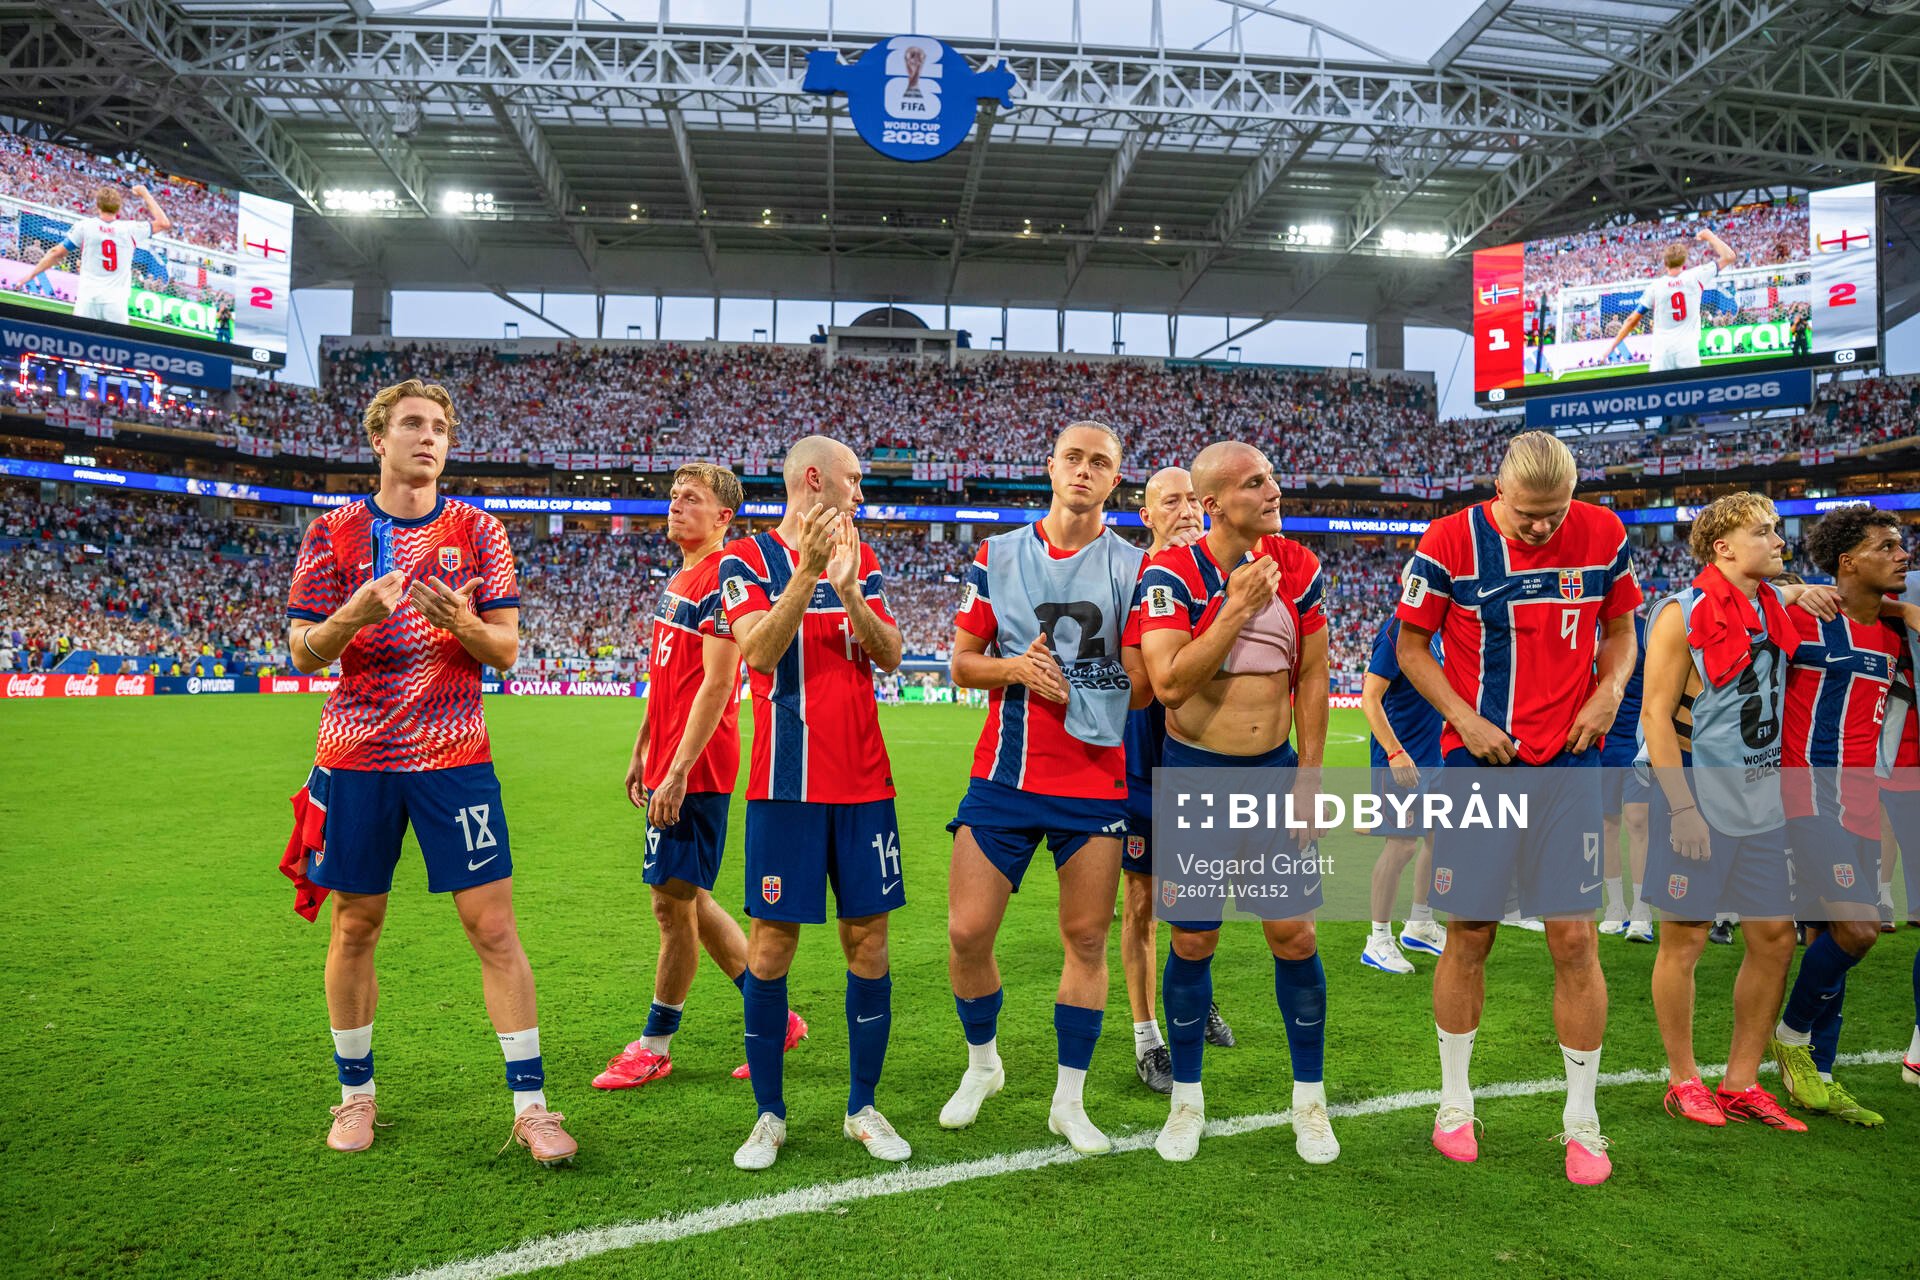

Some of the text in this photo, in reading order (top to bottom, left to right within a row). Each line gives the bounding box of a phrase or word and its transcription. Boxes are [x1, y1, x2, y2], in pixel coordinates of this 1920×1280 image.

[901, 101, 926, 112] FIFA
[883, 121, 941, 132] WORLD CUP
[882, 131, 941, 145] 2026
[101, 239, 118, 272] 9
[250, 286, 273, 310] 2
[1828, 282, 1857, 307] 2
[1671, 291, 1687, 322] 9
[1488, 328, 1510, 351] 1
[3, 329, 205, 377] WORLD CUP 2026
[1837, 352, 1853, 362] CC
[1550, 381, 1781, 418] FIFA WORLD CUP 2026
[312, 494, 351, 506] MIAMI
[484, 498, 612, 511] FIFA WORLD CUP 2026
[744, 503, 783, 514] MIAMI
[1328, 520, 1351, 531] FIFA
[1351, 520, 1388, 531] WORLD
[1388, 521, 1409, 532] CUP
[1560, 608, 1581, 650] 9
[655, 627, 674, 667] 16
[6, 674, 47, 697] Coca-Cola
[64, 675, 99, 697] Coca-Cola
[115, 675, 147, 696] Coca-Cola
[201, 678, 235, 692] HYUNDAI
[272, 678, 299, 693] Lenovo
[509, 681, 631, 696] QATAR AIRWAYS
[454, 803, 497, 852] 18
[871, 831, 900, 878] 14
[1583, 832, 1599, 876] 9
